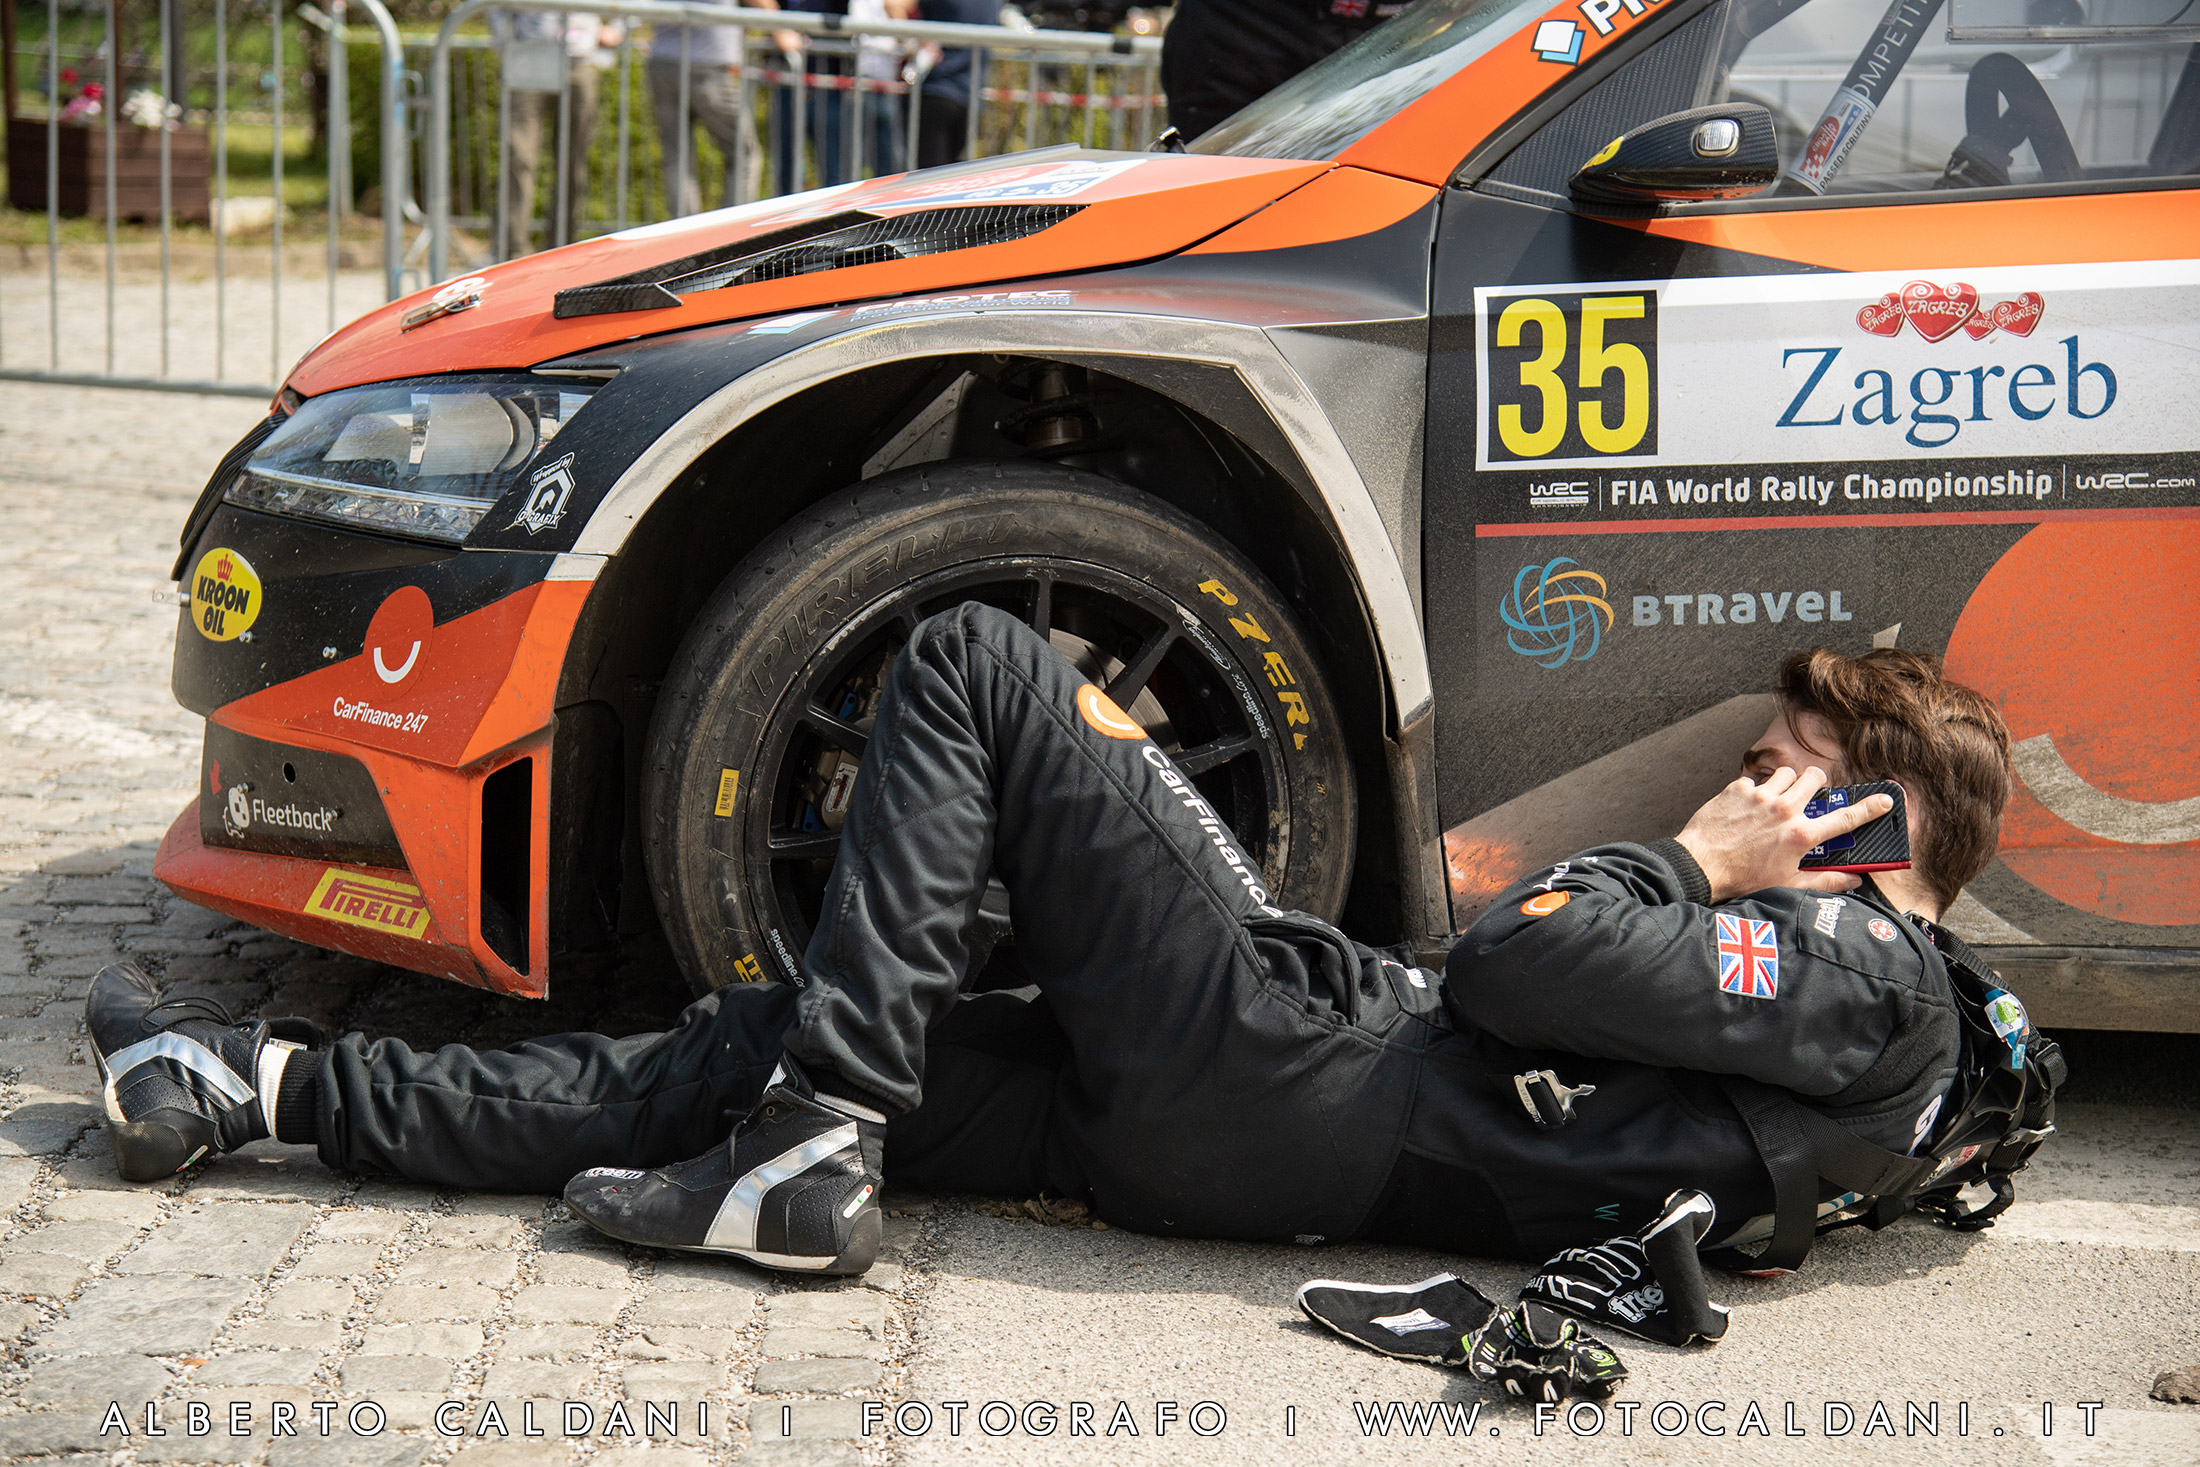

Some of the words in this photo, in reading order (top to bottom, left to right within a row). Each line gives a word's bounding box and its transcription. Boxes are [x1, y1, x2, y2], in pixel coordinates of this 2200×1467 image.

[1819, 154, 1845, 190] PASSED
[1841, 110, 1873, 155] SCRUTINY
[855, 289, 1073, 313] PROTEC
[1865, 302, 1902, 331] ZAGREB
[1907, 299, 1970, 318] ZAGREB
[1999, 303, 2040, 327] ZAGREB
[1496, 295, 1650, 457] 35
[1775, 335, 2117, 448] Zagreb
[1529, 481, 1590, 497] WRC
[1611, 479, 1659, 506] FIA
[1666, 476, 1751, 505] World
[1761, 475, 1835, 507] Rally
[1843, 469, 2051, 504] Championship
[197, 575, 251, 615] KROON
[203, 605, 225, 636] OIL
[333, 696, 403, 729] CarFinance
[401, 711, 429, 734] 247
[1242, 690, 1270, 740] speedline
[252, 798, 333, 832] Fleetback
[318, 876, 436, 930] PIRELLI
[771, 928, 798, 977] speedline
[1607, 1282, 1665, 1323] free
